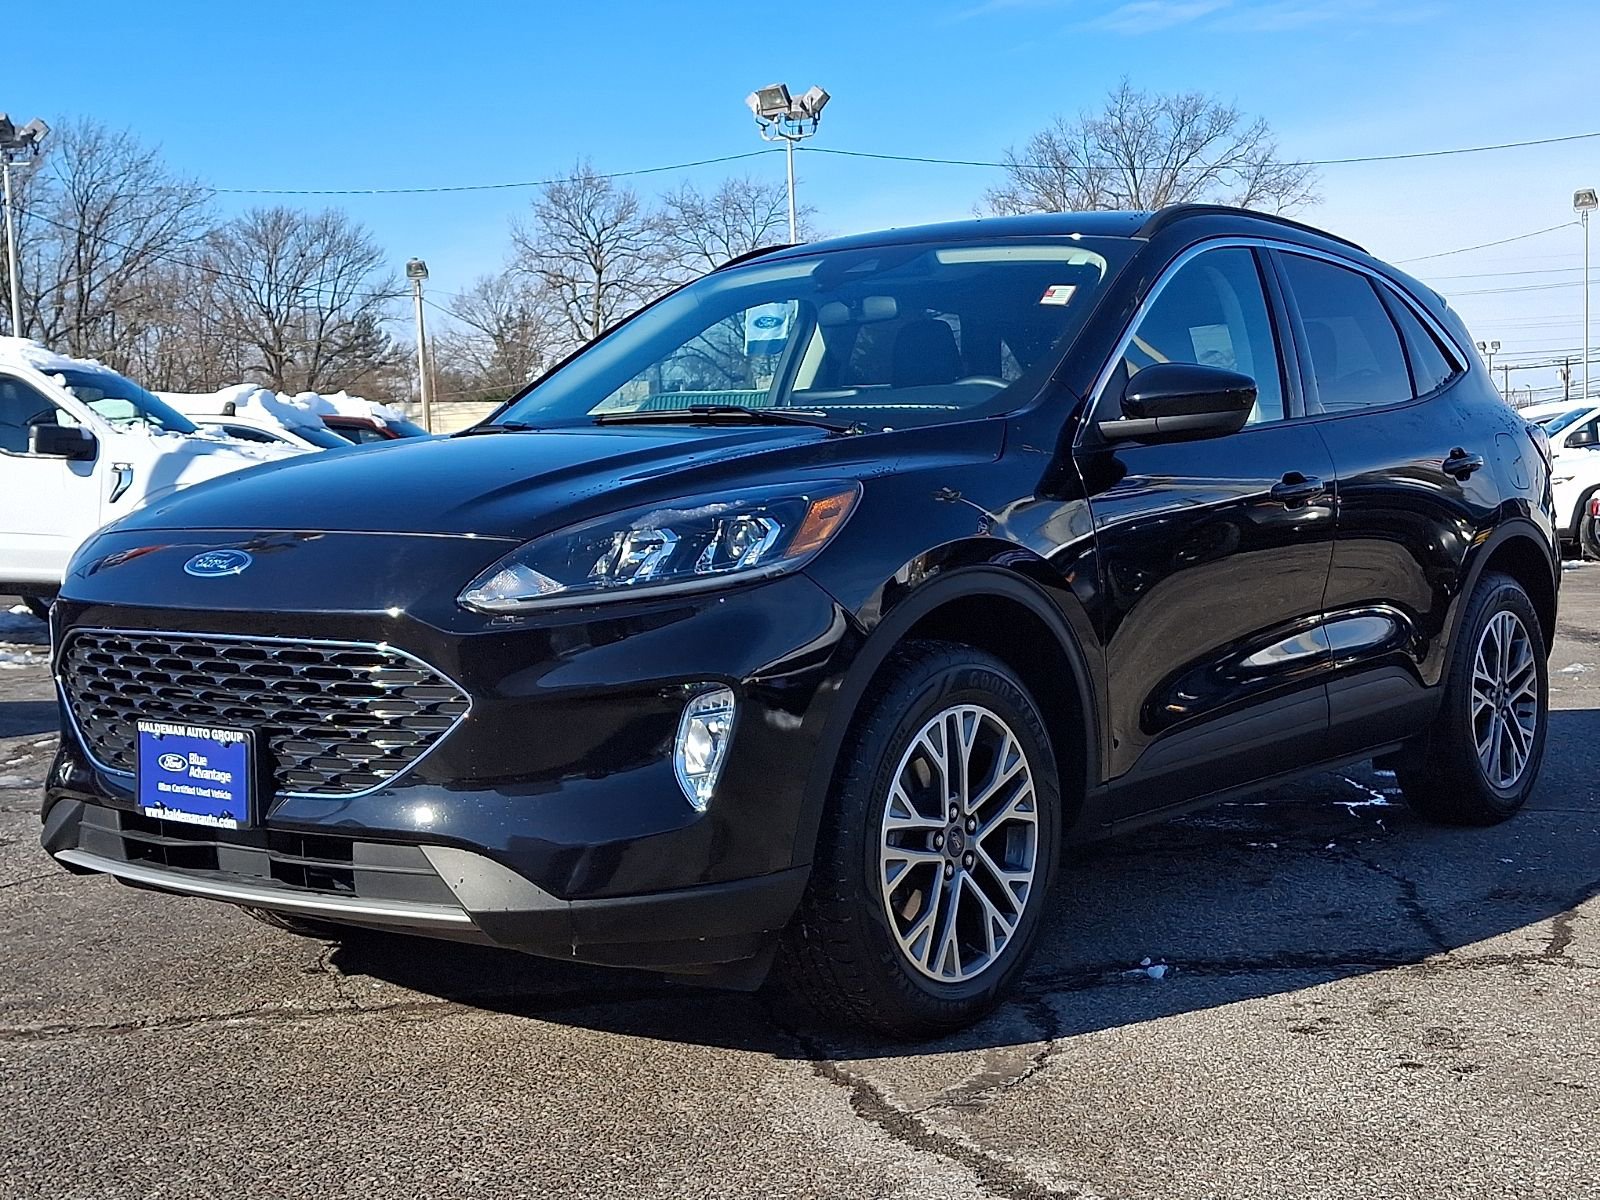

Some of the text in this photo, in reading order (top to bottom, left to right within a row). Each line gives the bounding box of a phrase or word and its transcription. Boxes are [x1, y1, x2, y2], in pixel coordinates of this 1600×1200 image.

[138, 722, 244, 742] HALDEMAN AUTO GROUP
[188, 752, 208, 766] Blue
[189, 766, 232, 783] Advantage
[172, 784, 195, 795] Certified
[196, 787, 211, 797] Used
[211, 789, 232, 800] Vehicle
[145, 807, 237, 829] www.haldemanauto.com
